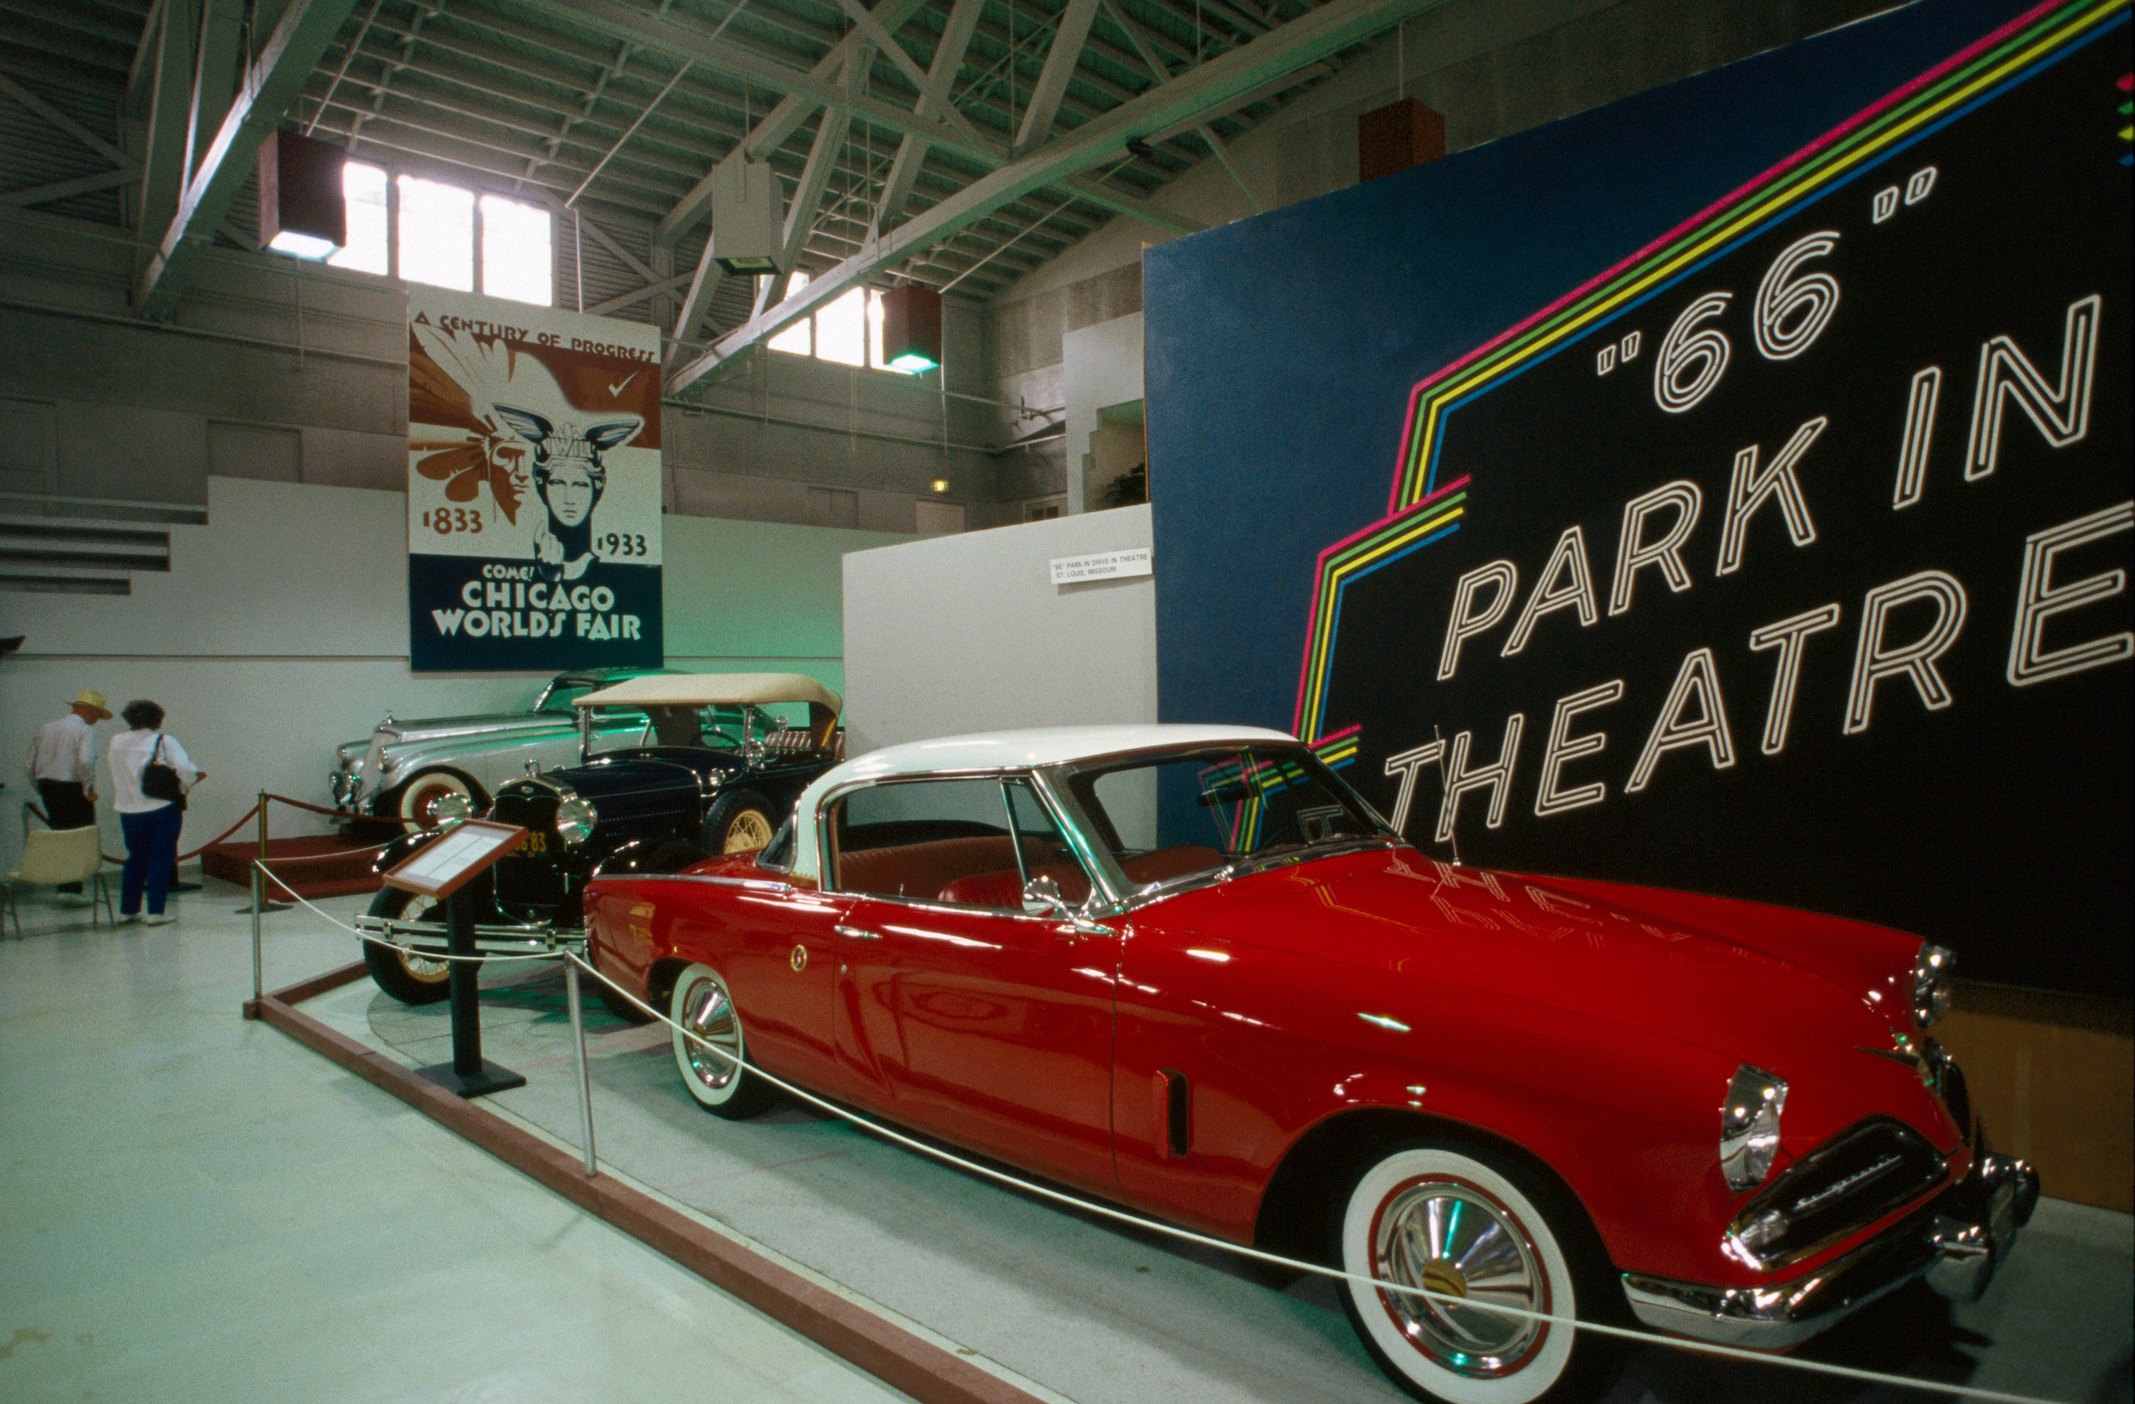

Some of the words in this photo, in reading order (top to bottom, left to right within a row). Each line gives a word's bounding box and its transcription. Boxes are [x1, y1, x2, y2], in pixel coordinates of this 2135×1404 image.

[413, 310, 430, 325] A
[439, 313, 529, 343] CENTURY
[537, 331, 560, 347] OF
[571, 337, 656, 362] PROGRESS
[1437, 417, 1828, 681] PARK
[1893, 295, 2101, 511] IN
[423, 507, 483, 535] 1833
[597, 532, 647, 557] 1933
[482, 563, 534, 582] COME!
[1067, 561, 1082, 569] PARK
[1092, 557, 1109, 565] DRIVE
[1120, 553, 1148, 561] THEATRE
[1088, 566, 1117, 575] MISSOURI
[461, 580, 615, 612] CHICAGO
[576, 612, 642, 640] FAIR
[1384, 500, 2134, 843] THEATRE
